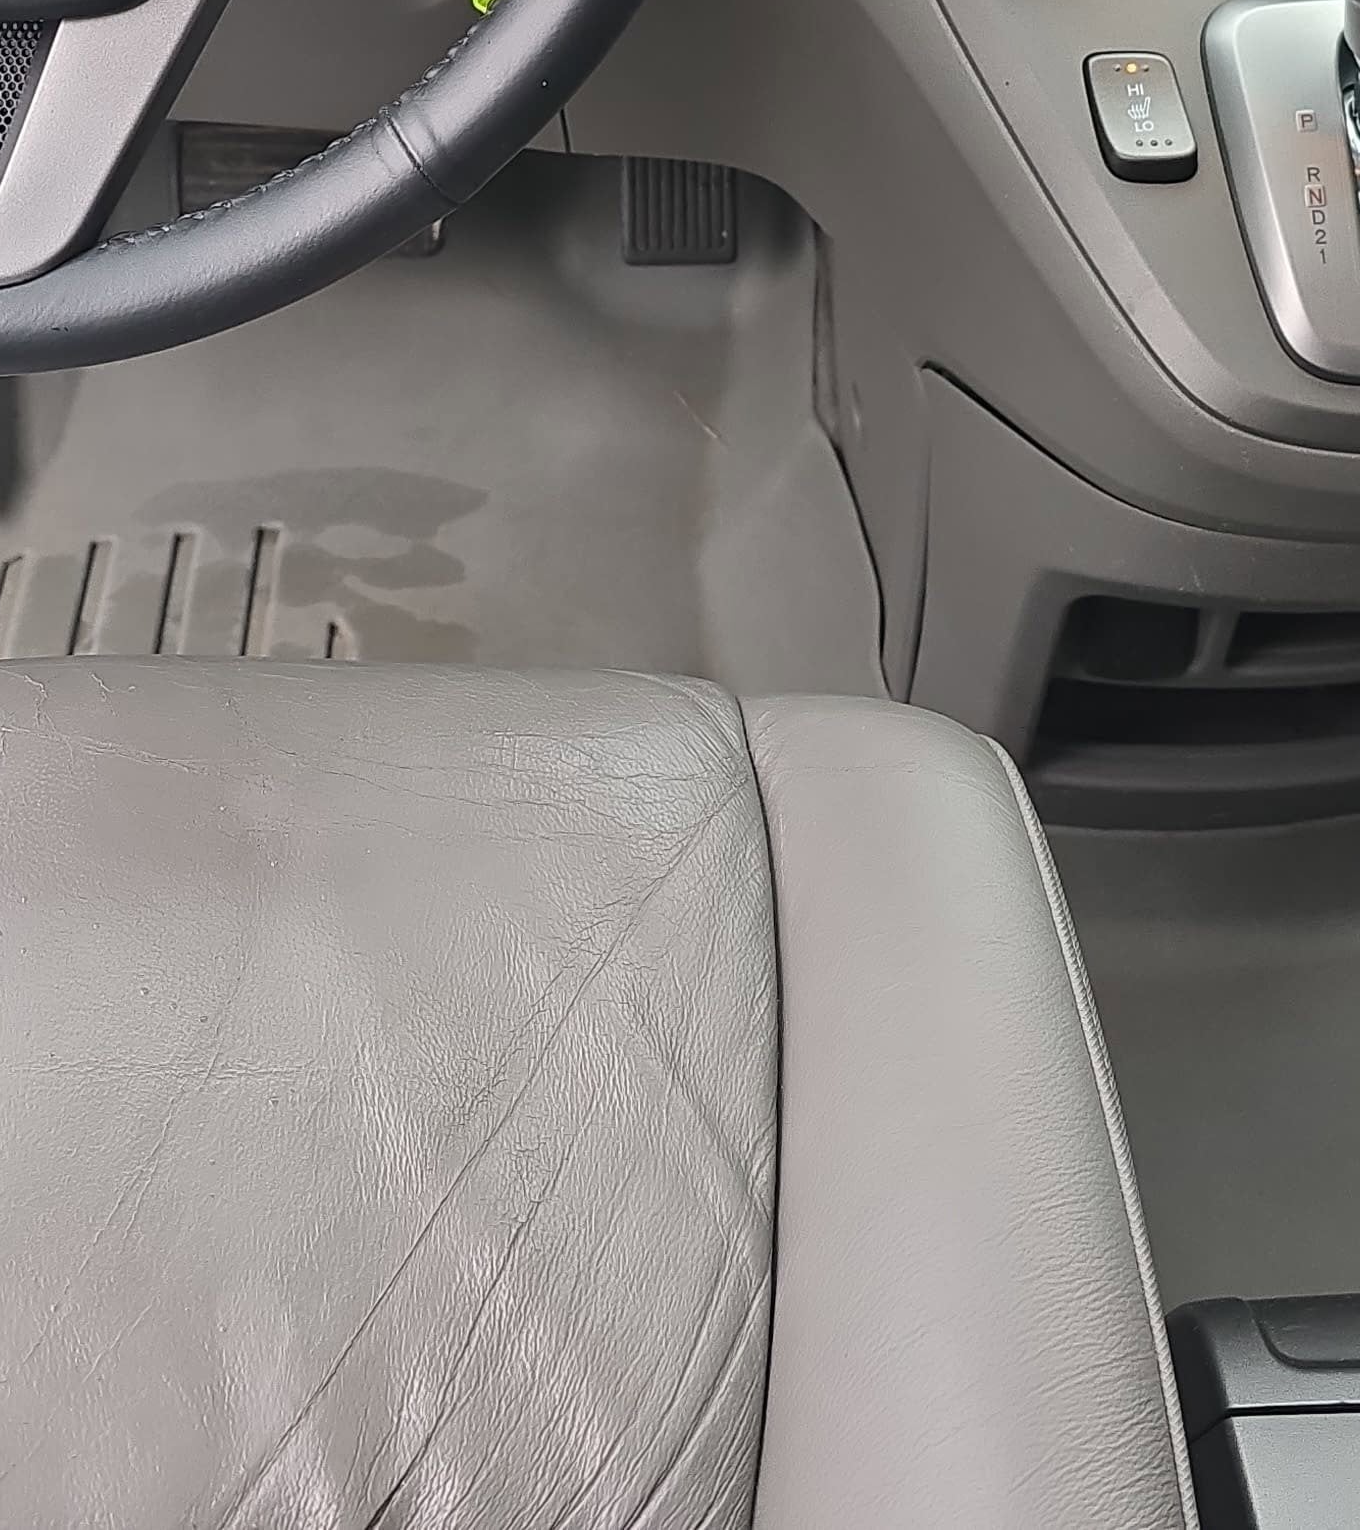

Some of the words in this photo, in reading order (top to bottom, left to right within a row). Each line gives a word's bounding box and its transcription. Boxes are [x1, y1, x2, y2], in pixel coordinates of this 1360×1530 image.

[1127, 83, 1144, 97] HI
[1134, 121, 1154, 132] LO
[1300, 114, 1314, 128] P
[1307, 167, 1321, 182] R
[1308, 189, 1323, 204] N
[1312, 210, 1326, 225] D
[1315, 229, 1327, 245] 2
[1319, 249, 1327, 264] 1
